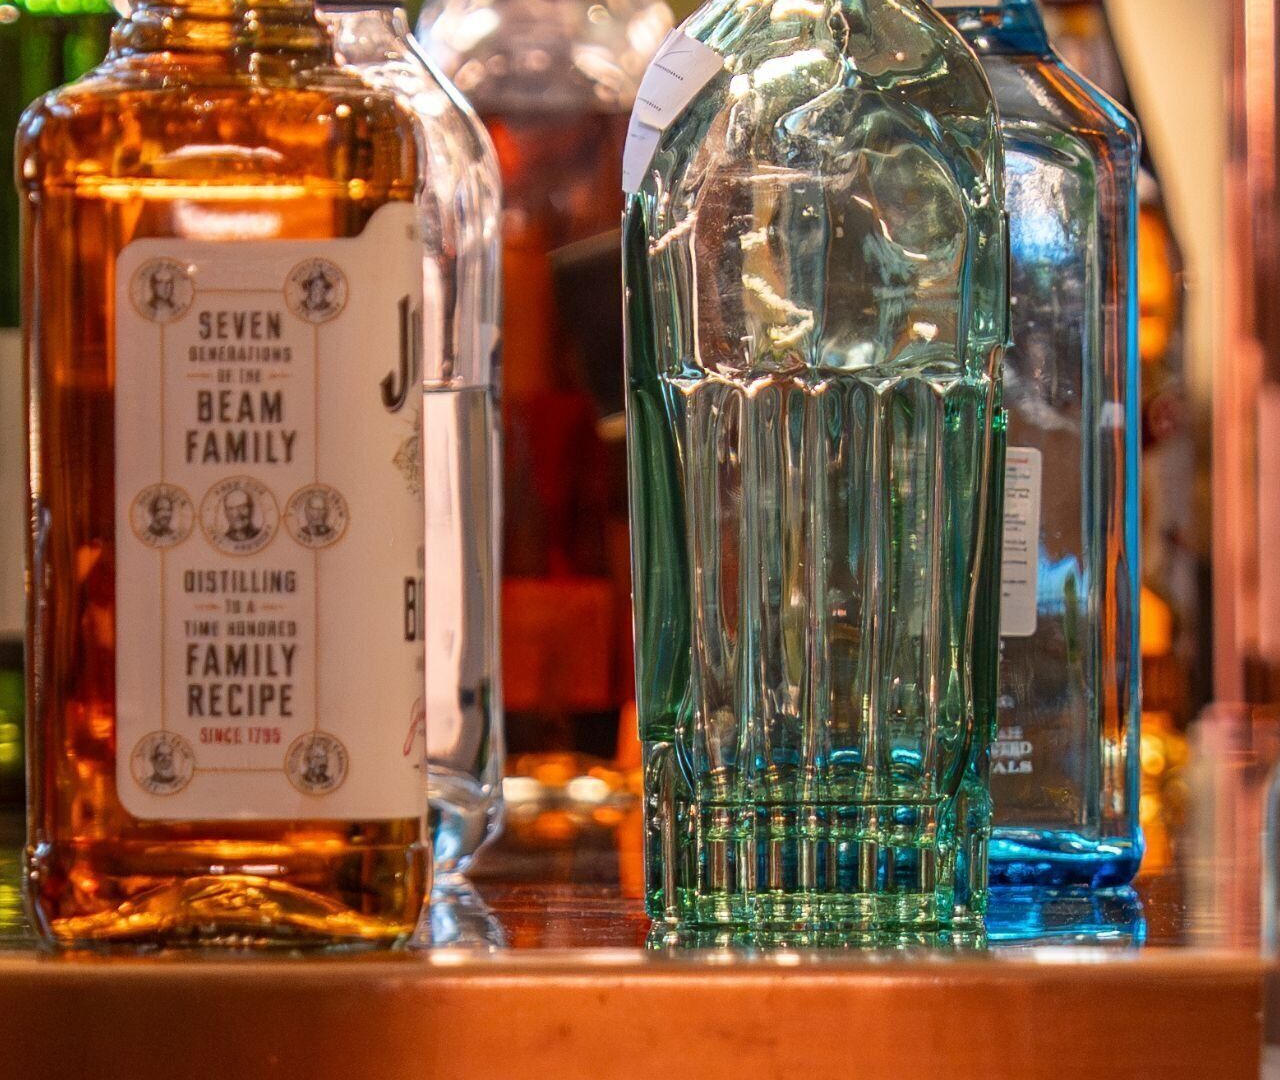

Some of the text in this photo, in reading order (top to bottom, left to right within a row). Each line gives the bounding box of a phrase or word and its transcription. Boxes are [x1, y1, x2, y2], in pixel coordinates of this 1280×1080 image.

[198, 310, 282, 340] SEVEN
[188, 346, 293, 363] GENERATIONS
[217, 369, 262, 383] OF THE
[197, 390, 283, 423] BEAM
[185, 430, 297, 465] FAMILY
[183, 570, 297, 594] DISTILLING
[224, 599, 256, 614] TO A
[184, 620, 297, 637] TIME HONORED
[185, 643, 298, 677] FAMILY
[187, 684, 294, 718] RECIPE
[200, 726, 282, 745] SINCE 1795
